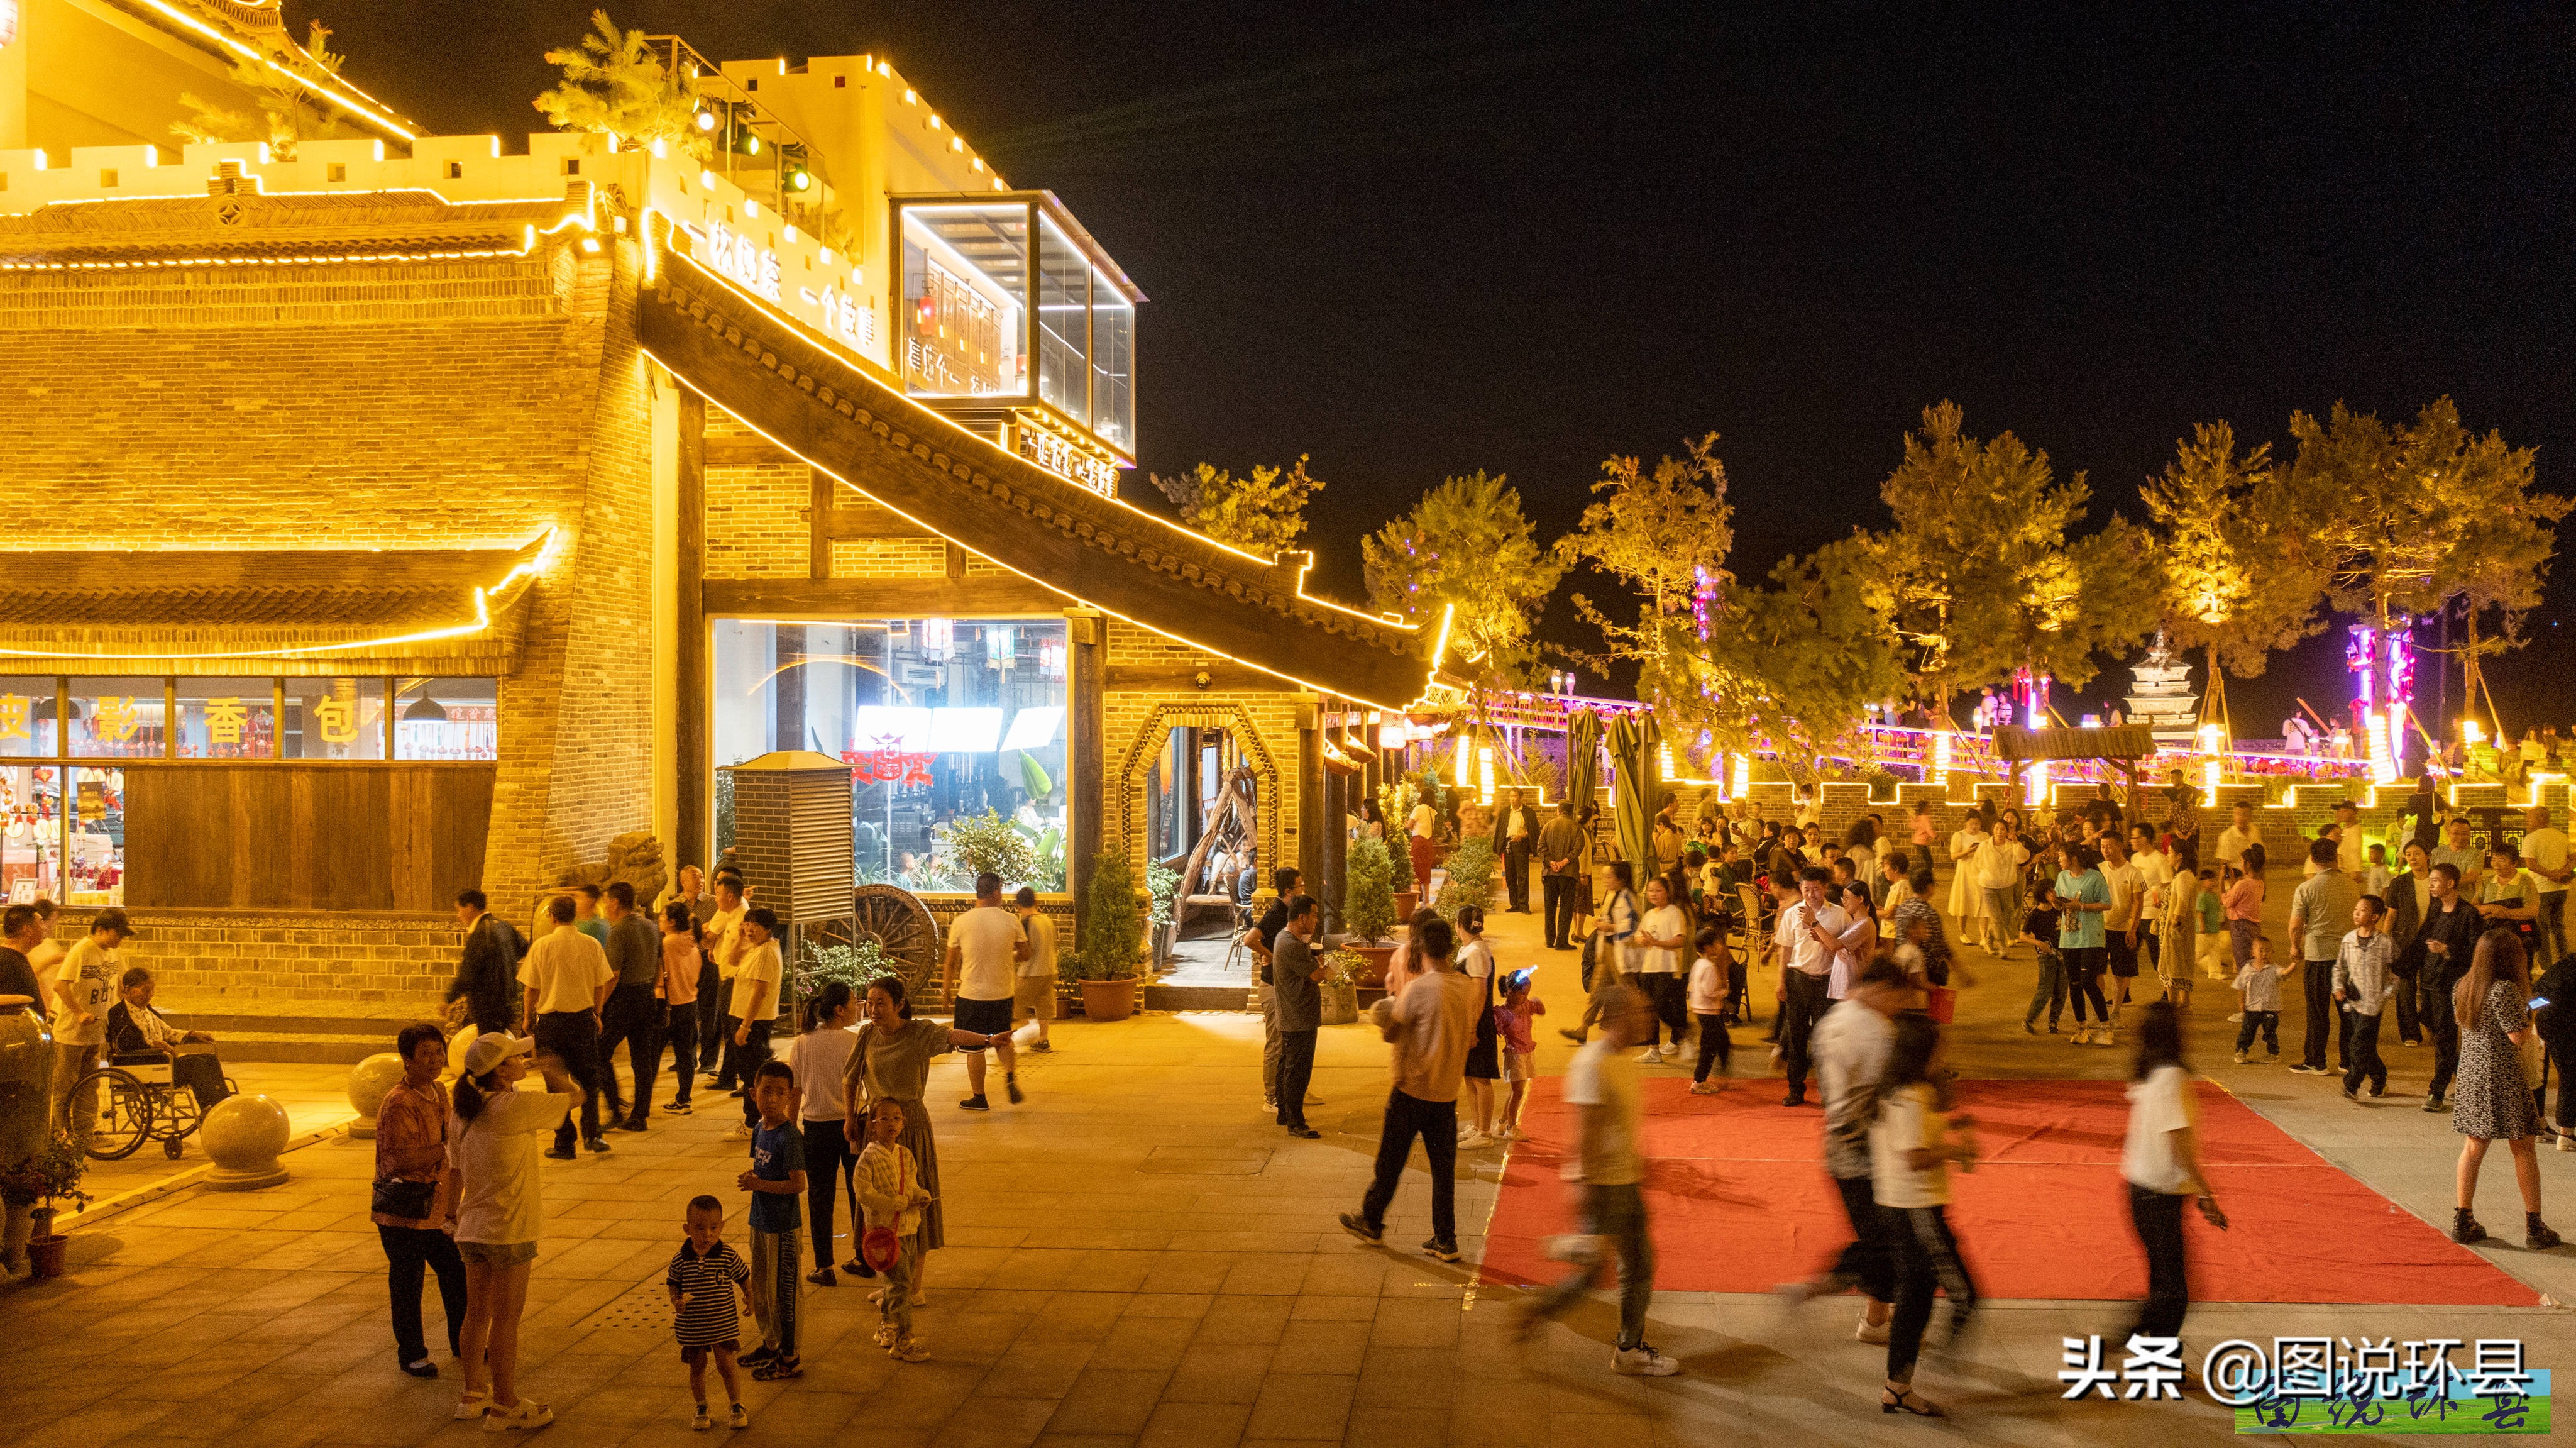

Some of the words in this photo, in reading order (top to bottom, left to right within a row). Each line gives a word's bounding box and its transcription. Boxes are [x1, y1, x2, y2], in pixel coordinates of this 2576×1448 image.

[683, 220, 781, 301] 一杯奶茶
[800, 284, 874, 345] 一个故事
[0, 693, 359, 743] 皮影香包
